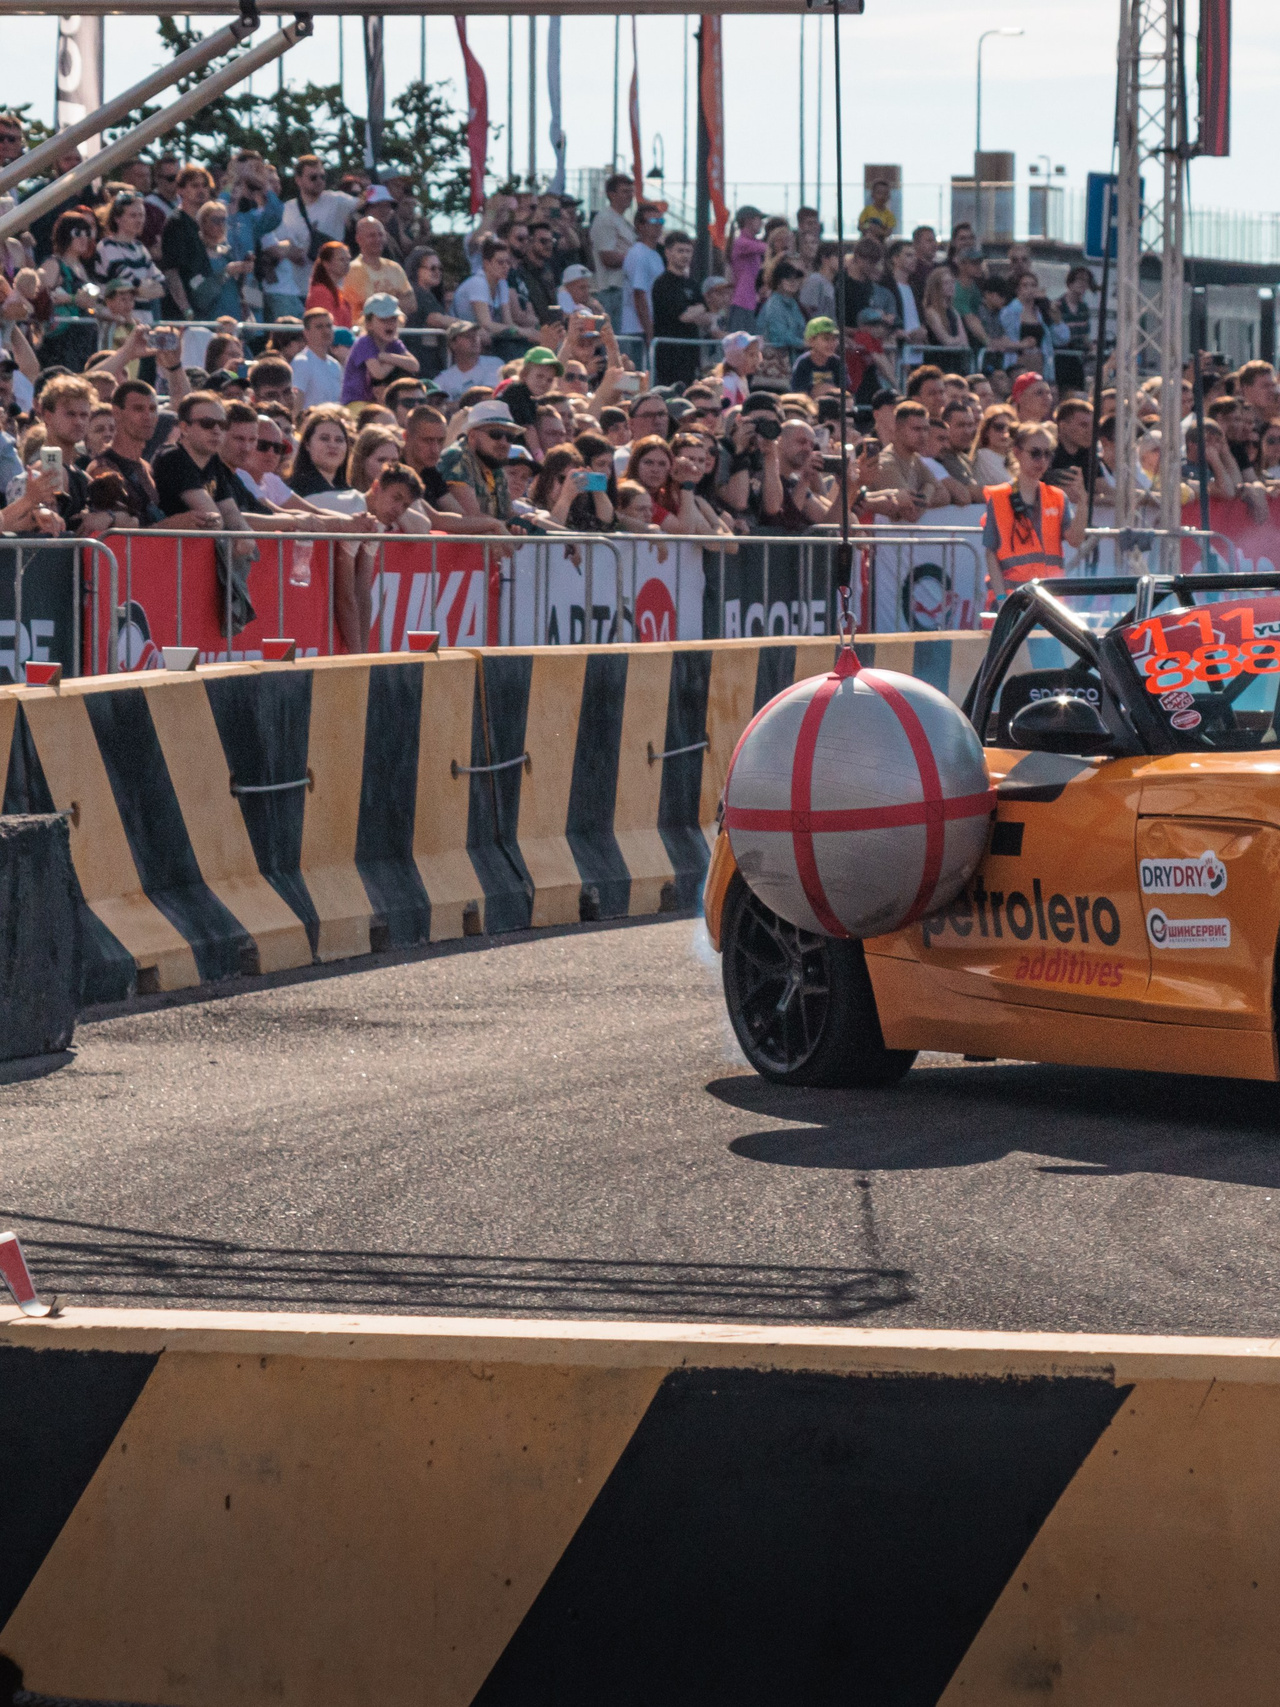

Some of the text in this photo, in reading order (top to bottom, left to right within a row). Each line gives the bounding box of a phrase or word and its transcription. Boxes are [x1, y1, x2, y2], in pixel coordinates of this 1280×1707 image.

[1129, 607, 1254, 656] 111
[1168, 924, 1228, 938] ШИНСЕРВИС
[1015, 948, 1124, 988] additives
